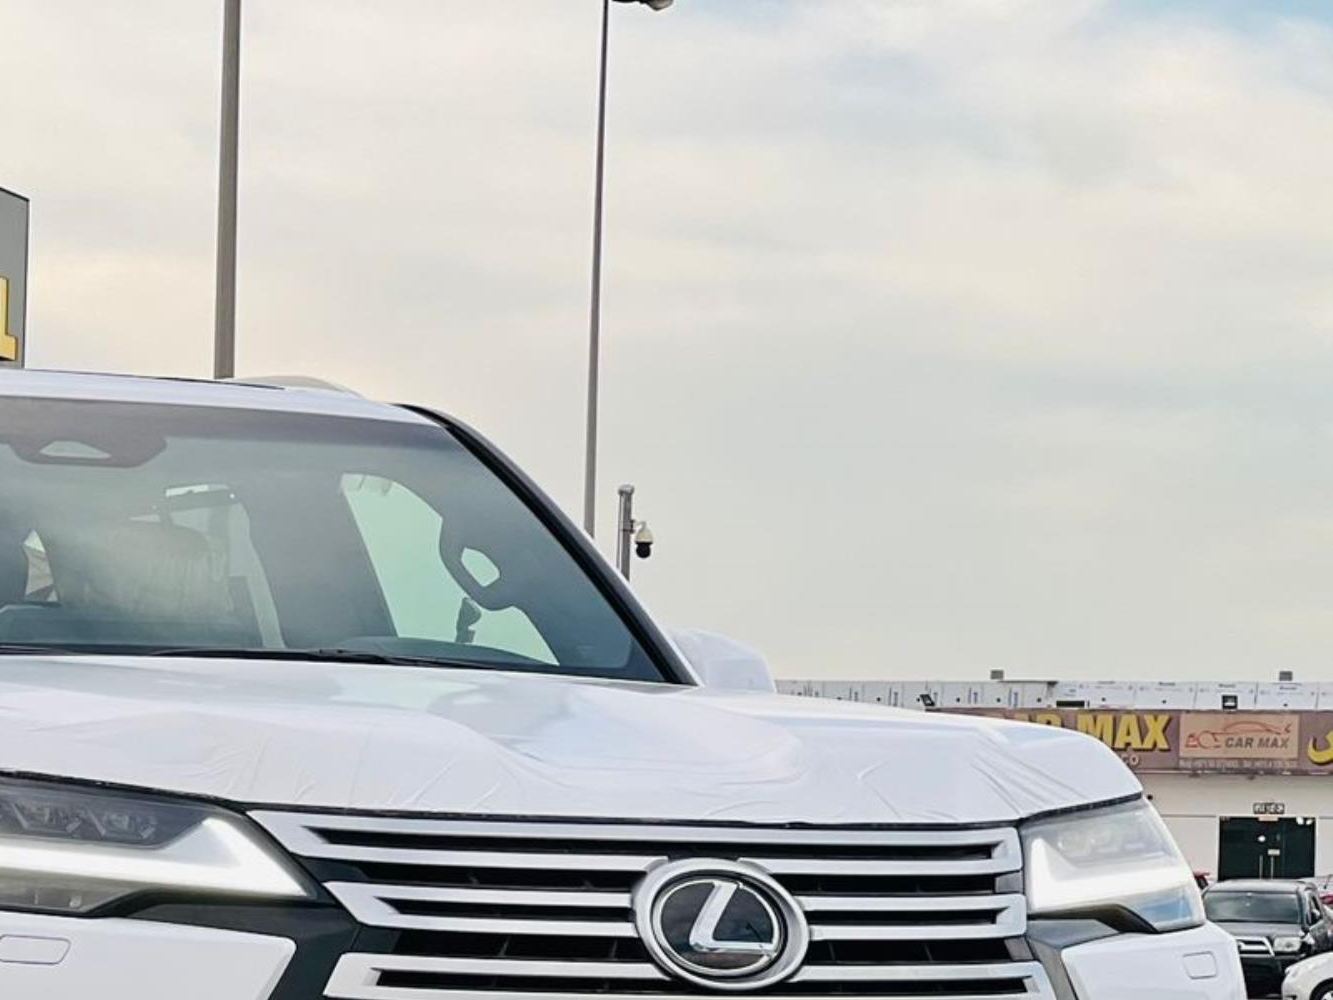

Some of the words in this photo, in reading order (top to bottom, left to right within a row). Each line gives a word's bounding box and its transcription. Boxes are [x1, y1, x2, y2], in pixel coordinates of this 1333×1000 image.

[1076, 713, 1170, 750] MAX
[1225, 737, 1254, 749] CAR
[1257, 737, 1290, 749] MAX
